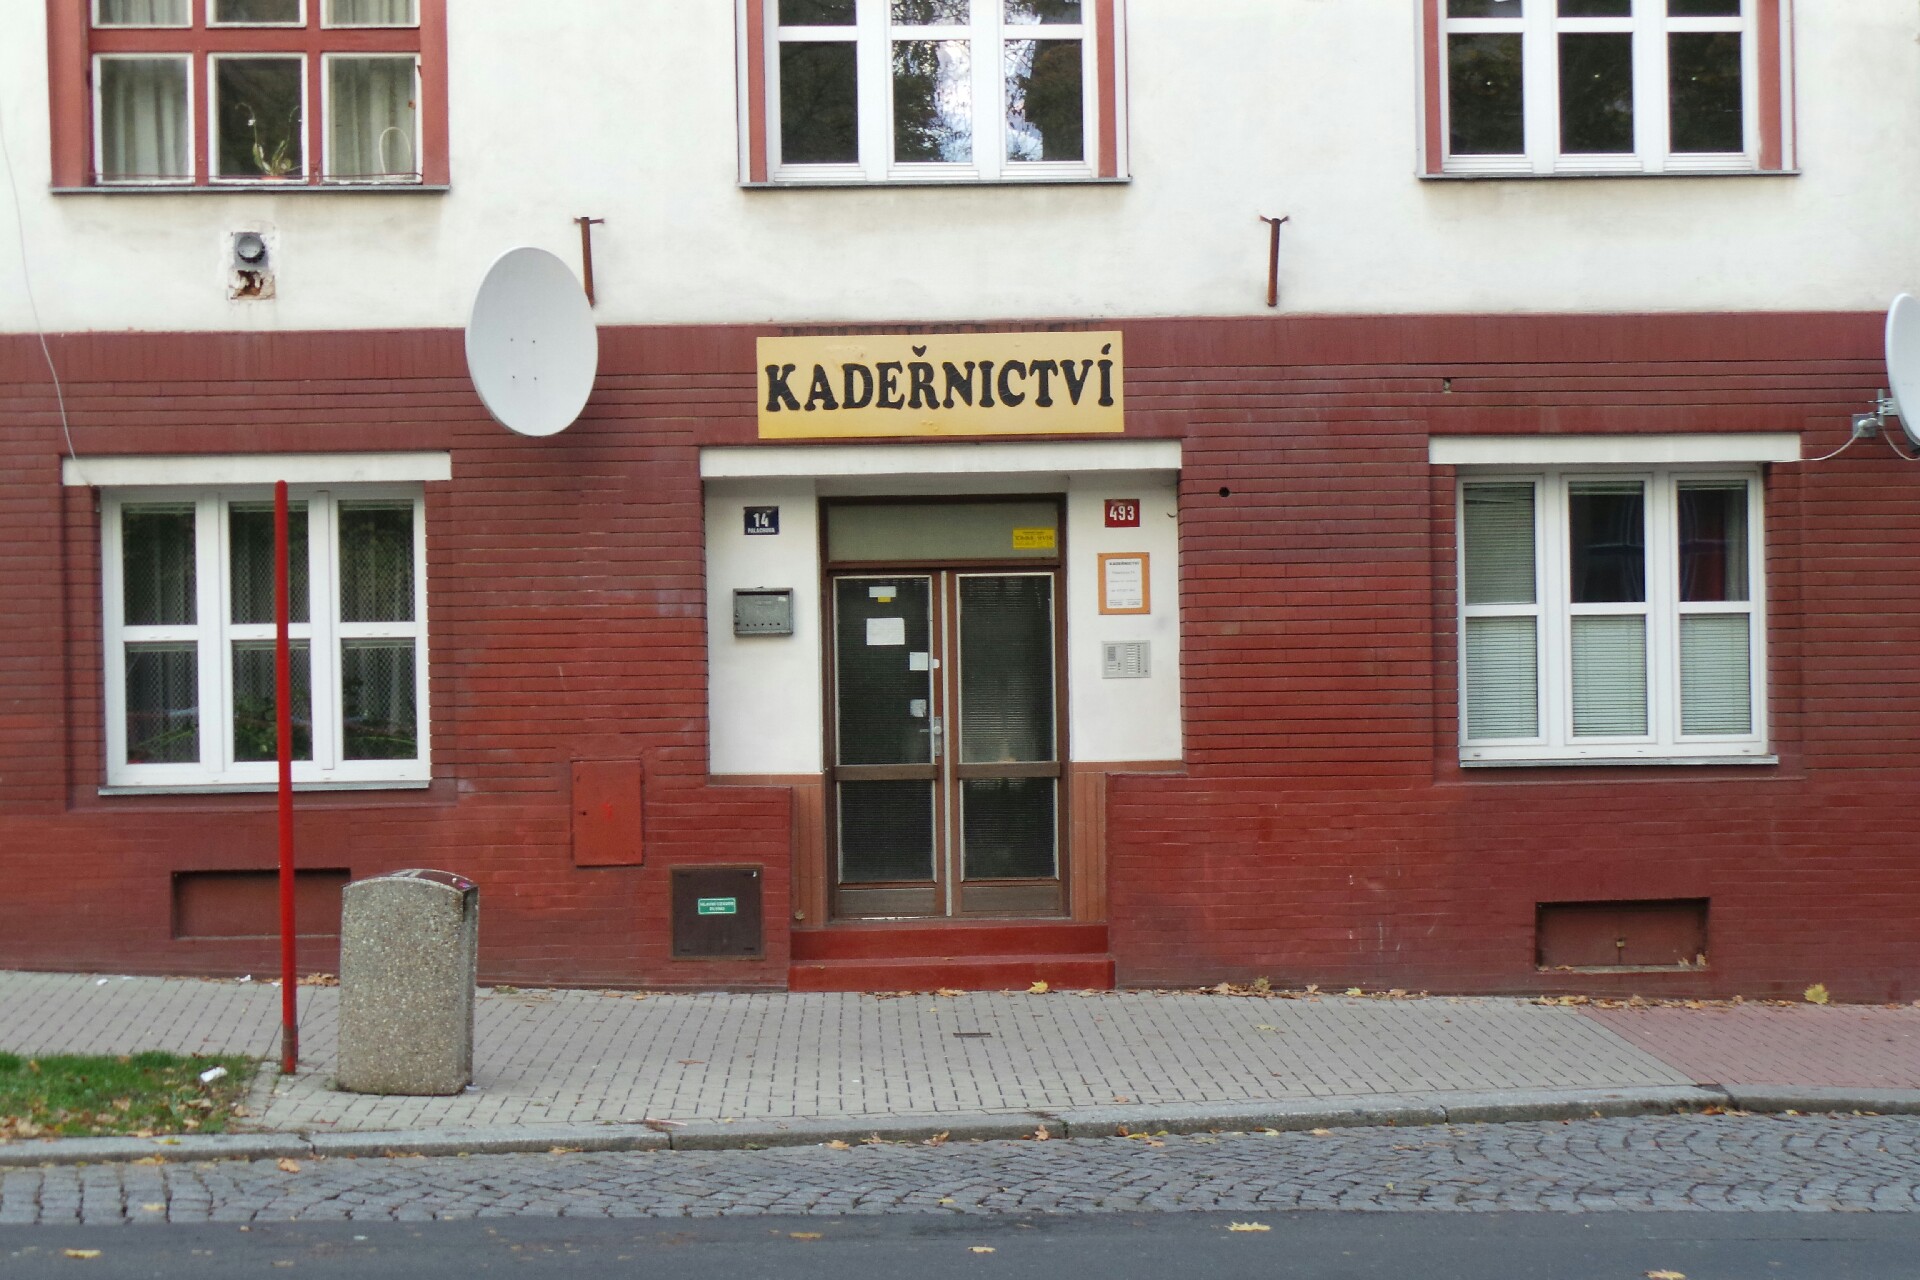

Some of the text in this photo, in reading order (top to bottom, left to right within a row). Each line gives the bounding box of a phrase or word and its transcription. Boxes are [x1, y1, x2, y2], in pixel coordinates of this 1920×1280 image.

[765, 343, 1114, 412] KADEŘNICTVÍ
[753, 513, 769, 527] 14
[1110, 505, 1134, 520] 493
